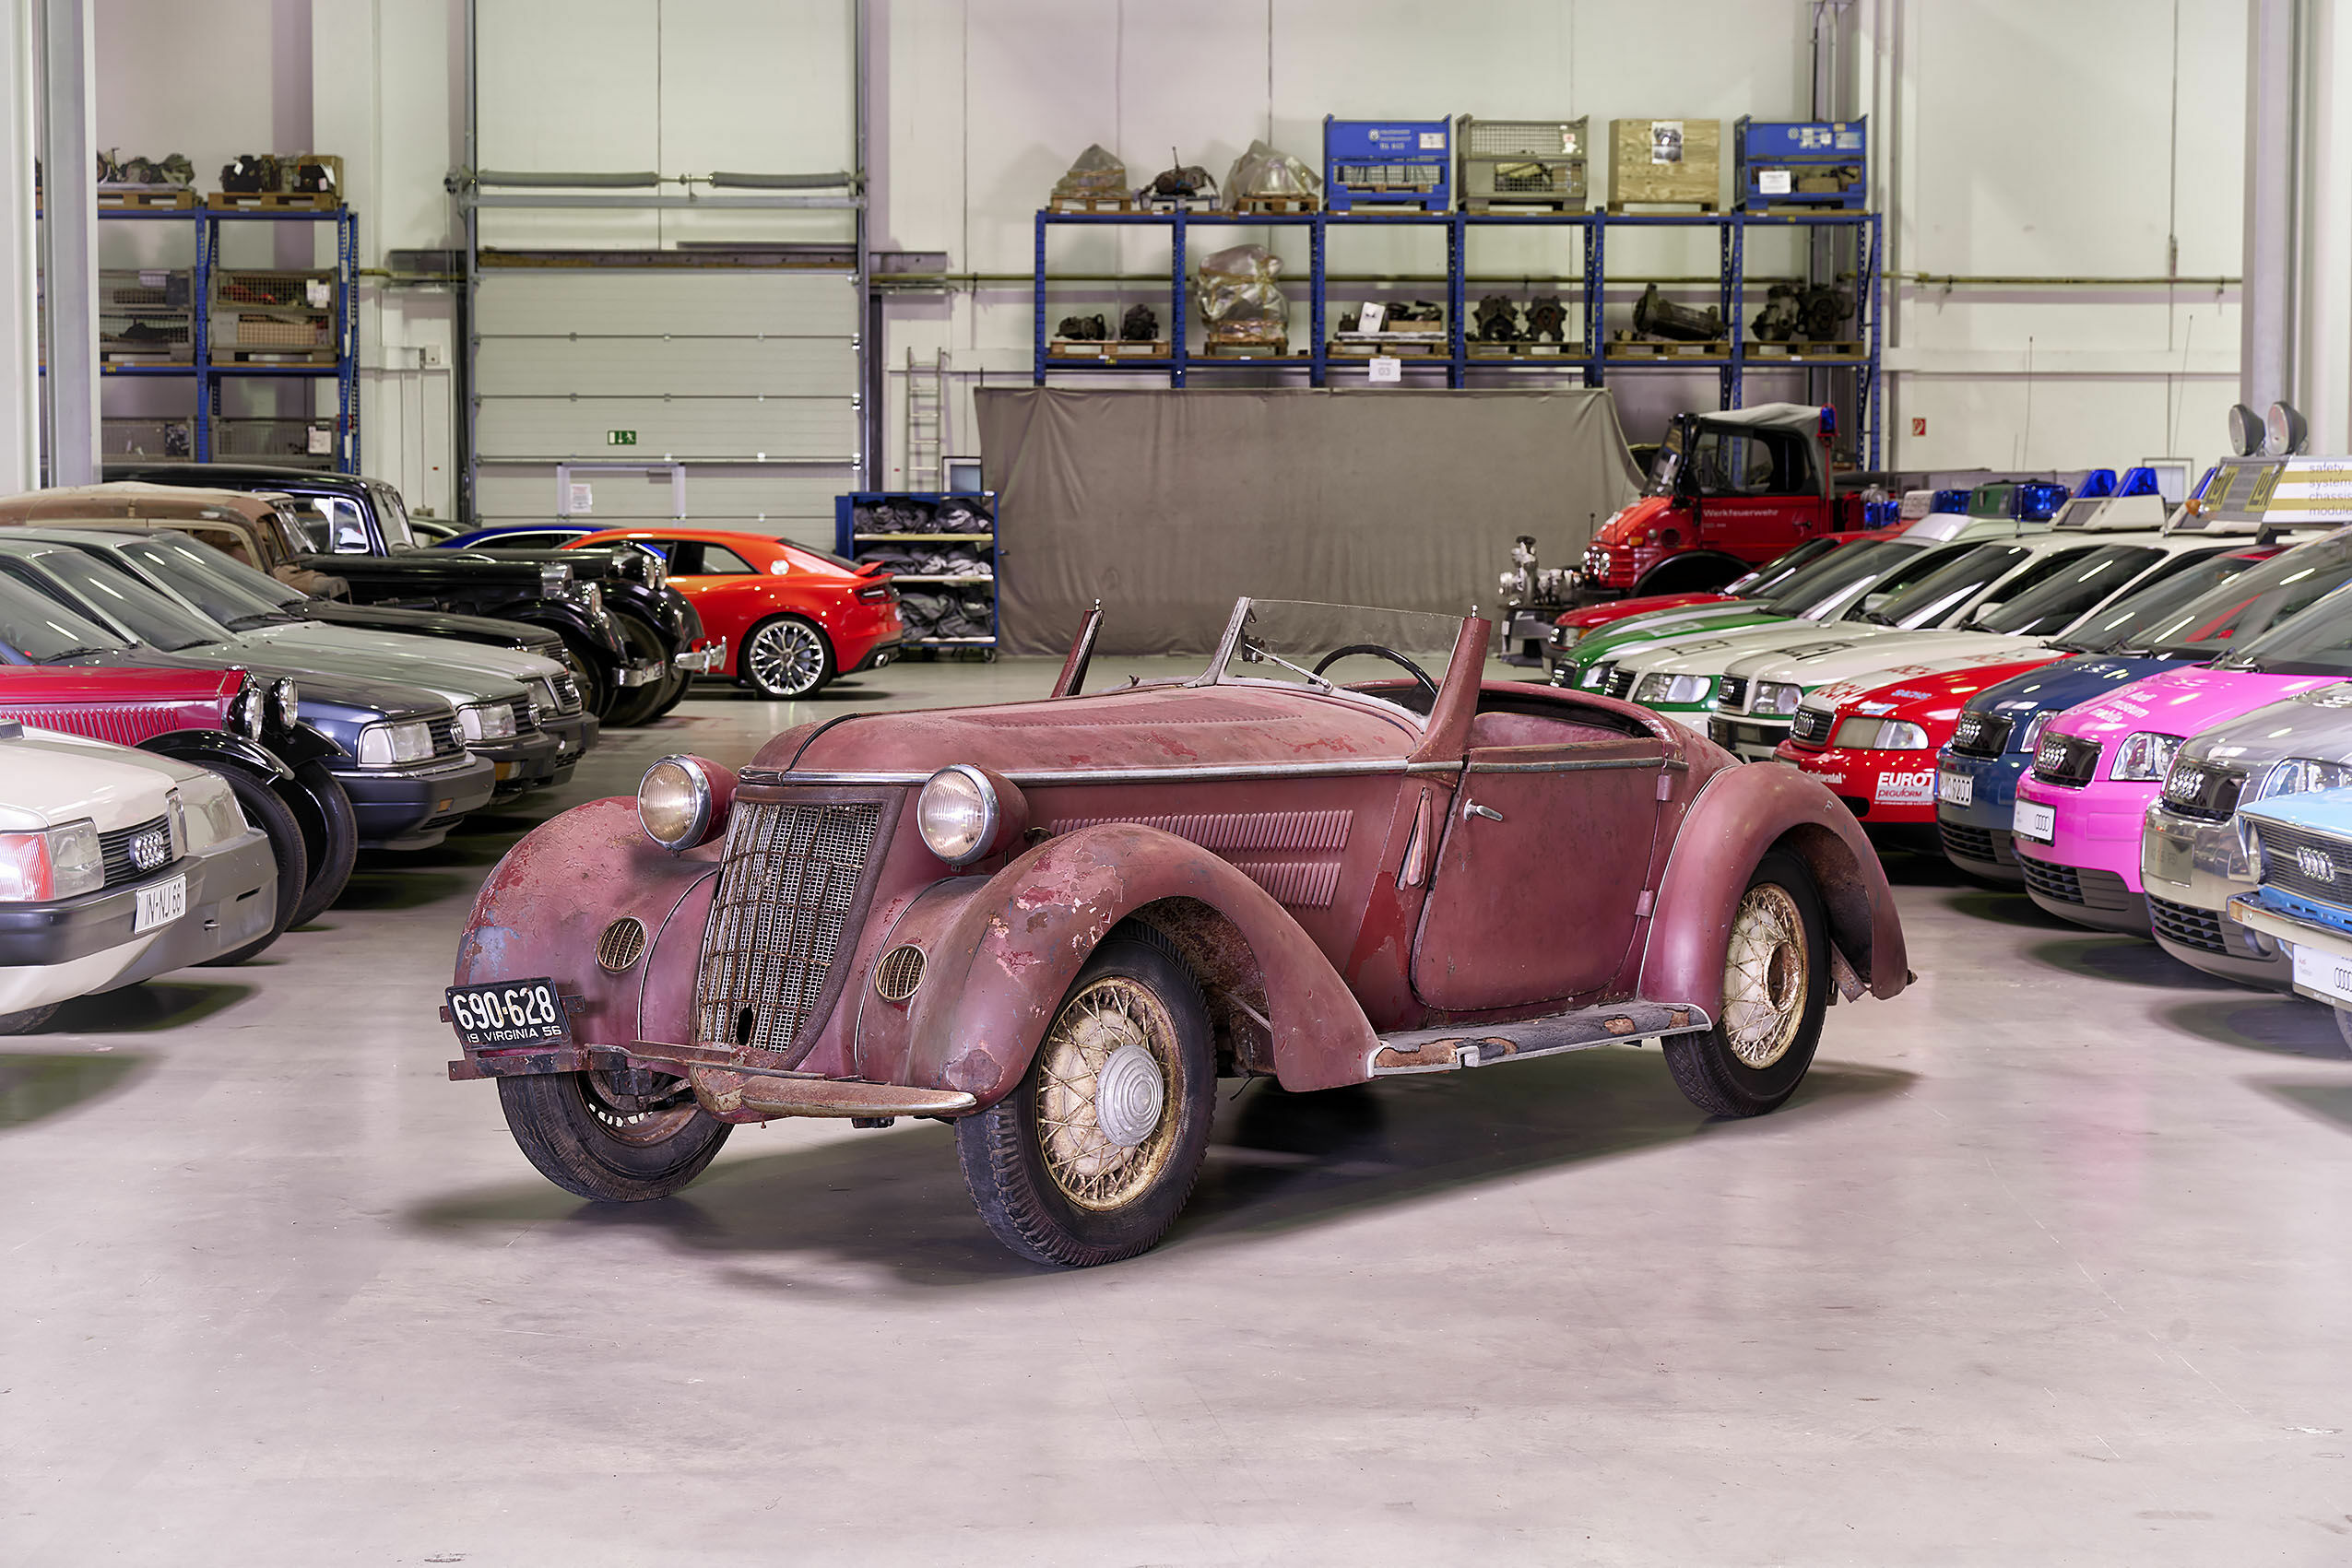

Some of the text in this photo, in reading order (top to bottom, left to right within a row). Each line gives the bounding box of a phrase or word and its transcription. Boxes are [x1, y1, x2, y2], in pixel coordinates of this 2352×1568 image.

[2309, 461, 2345, 476] safety
[452, 985, 556, 1031] 690-628
[467, 1025, 562, 1043] 19 VIRGINIA 56
